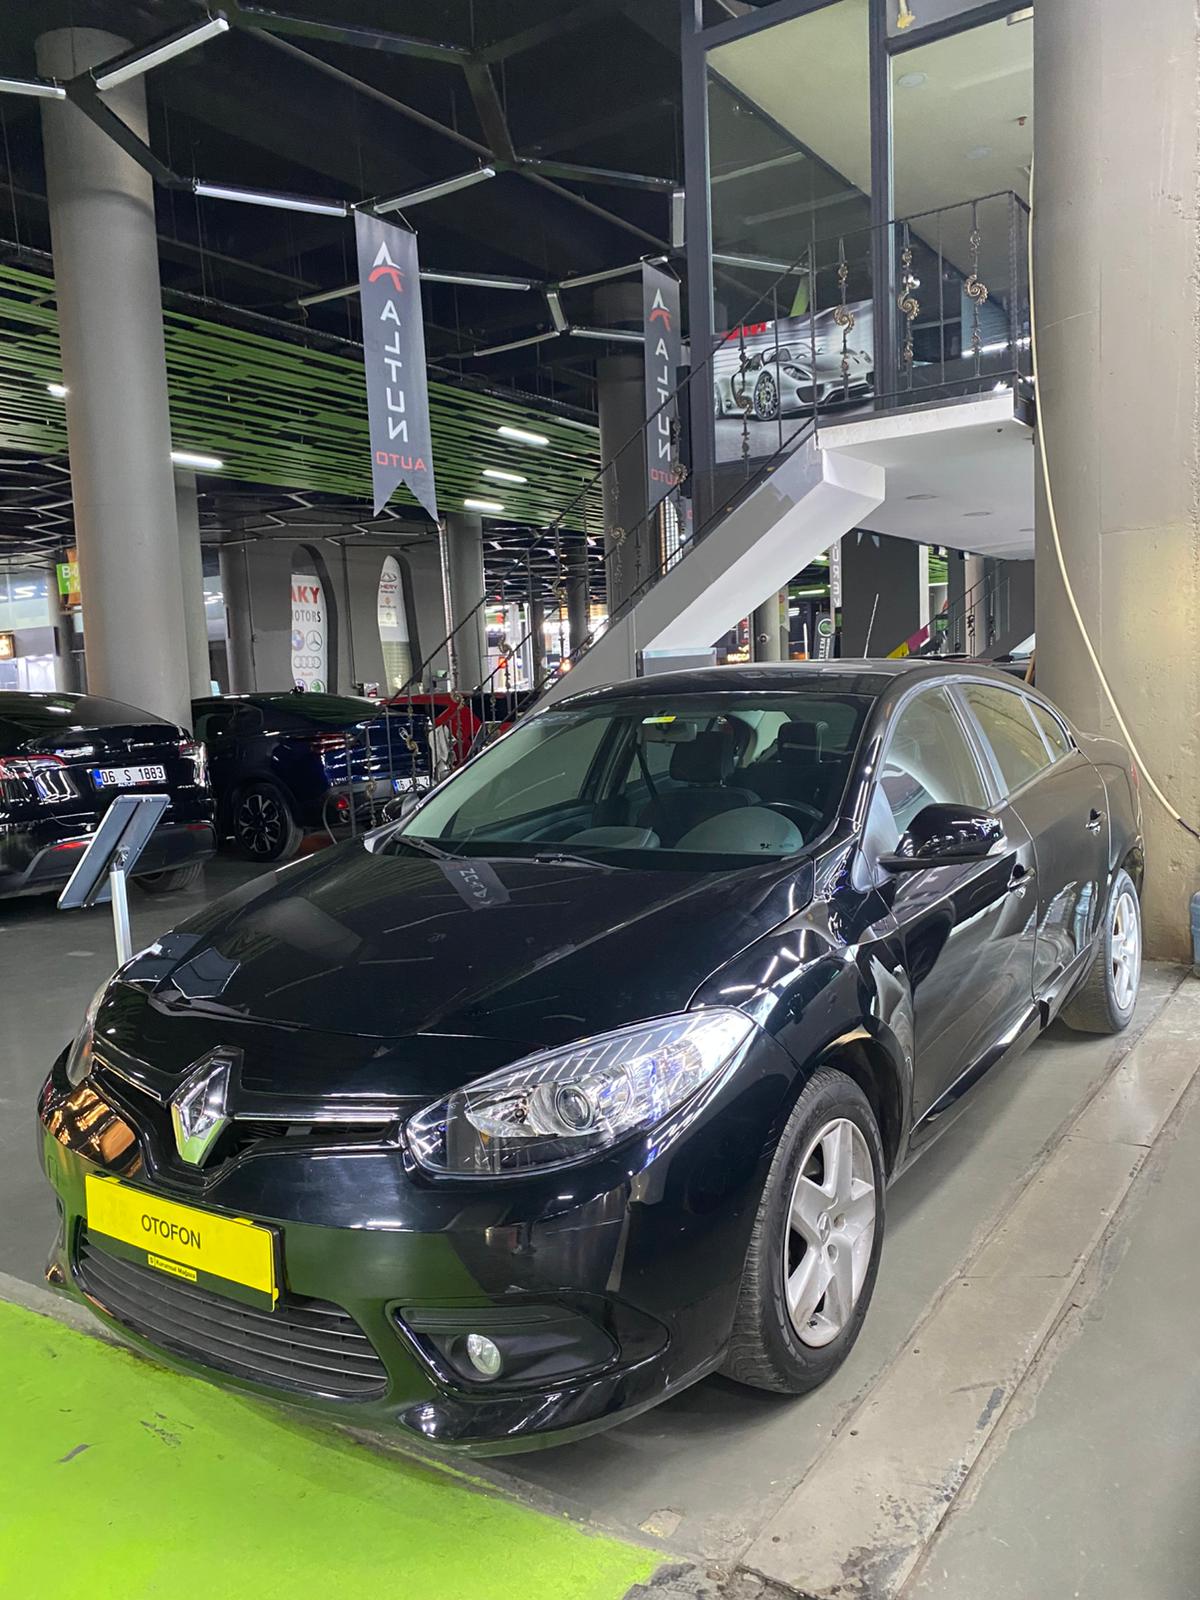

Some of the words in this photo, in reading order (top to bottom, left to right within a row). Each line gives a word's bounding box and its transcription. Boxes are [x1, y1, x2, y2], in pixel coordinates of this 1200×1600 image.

[291, 610, 322, 623] OTORS
[101, 771, 116, 784] 06
[124, 769, 132, 781] S
[138, 766, 164, 780] 1883
[141, 1214, 201, 1250] OTOFON
